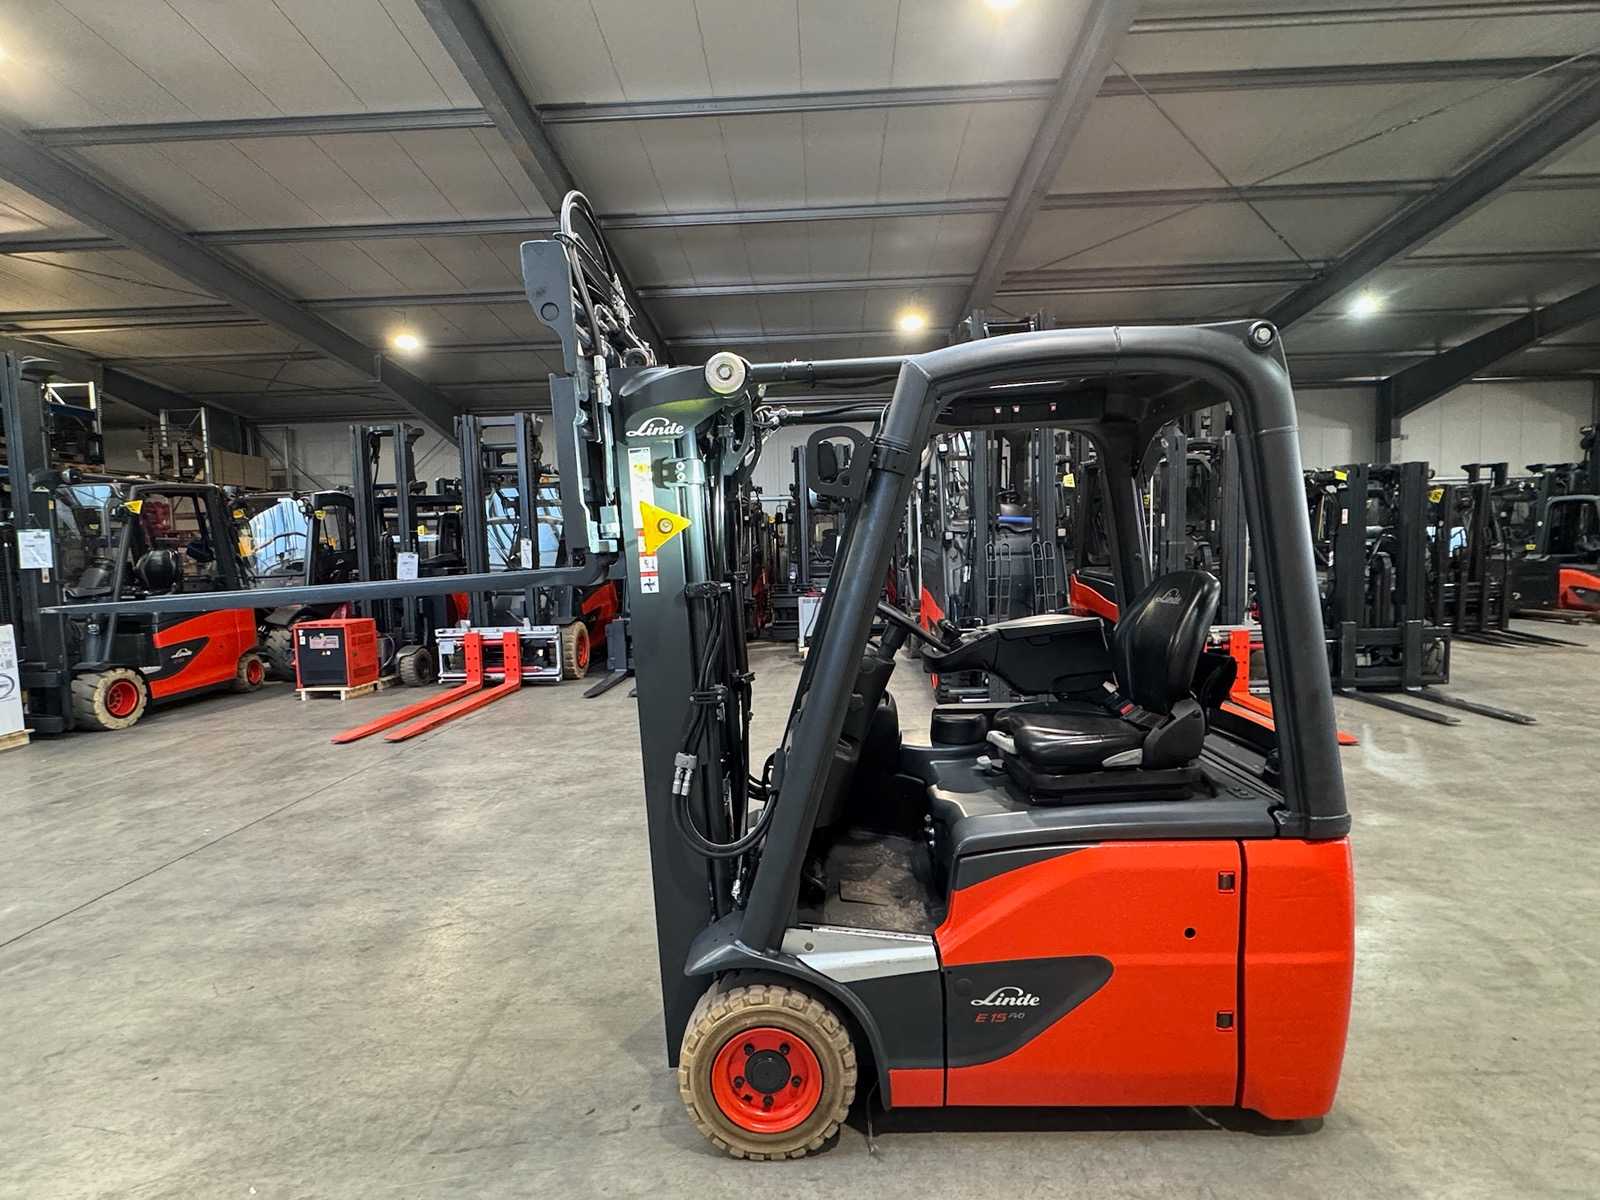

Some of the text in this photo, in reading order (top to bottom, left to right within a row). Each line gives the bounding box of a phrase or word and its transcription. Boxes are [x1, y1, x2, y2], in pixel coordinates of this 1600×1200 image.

[625, 417, 685, 436] Linde
[970, 986, 1040, 1006] Linde
[975, 1013, 988, 1023] E
[992, 1013, 1008, 1023] 15
